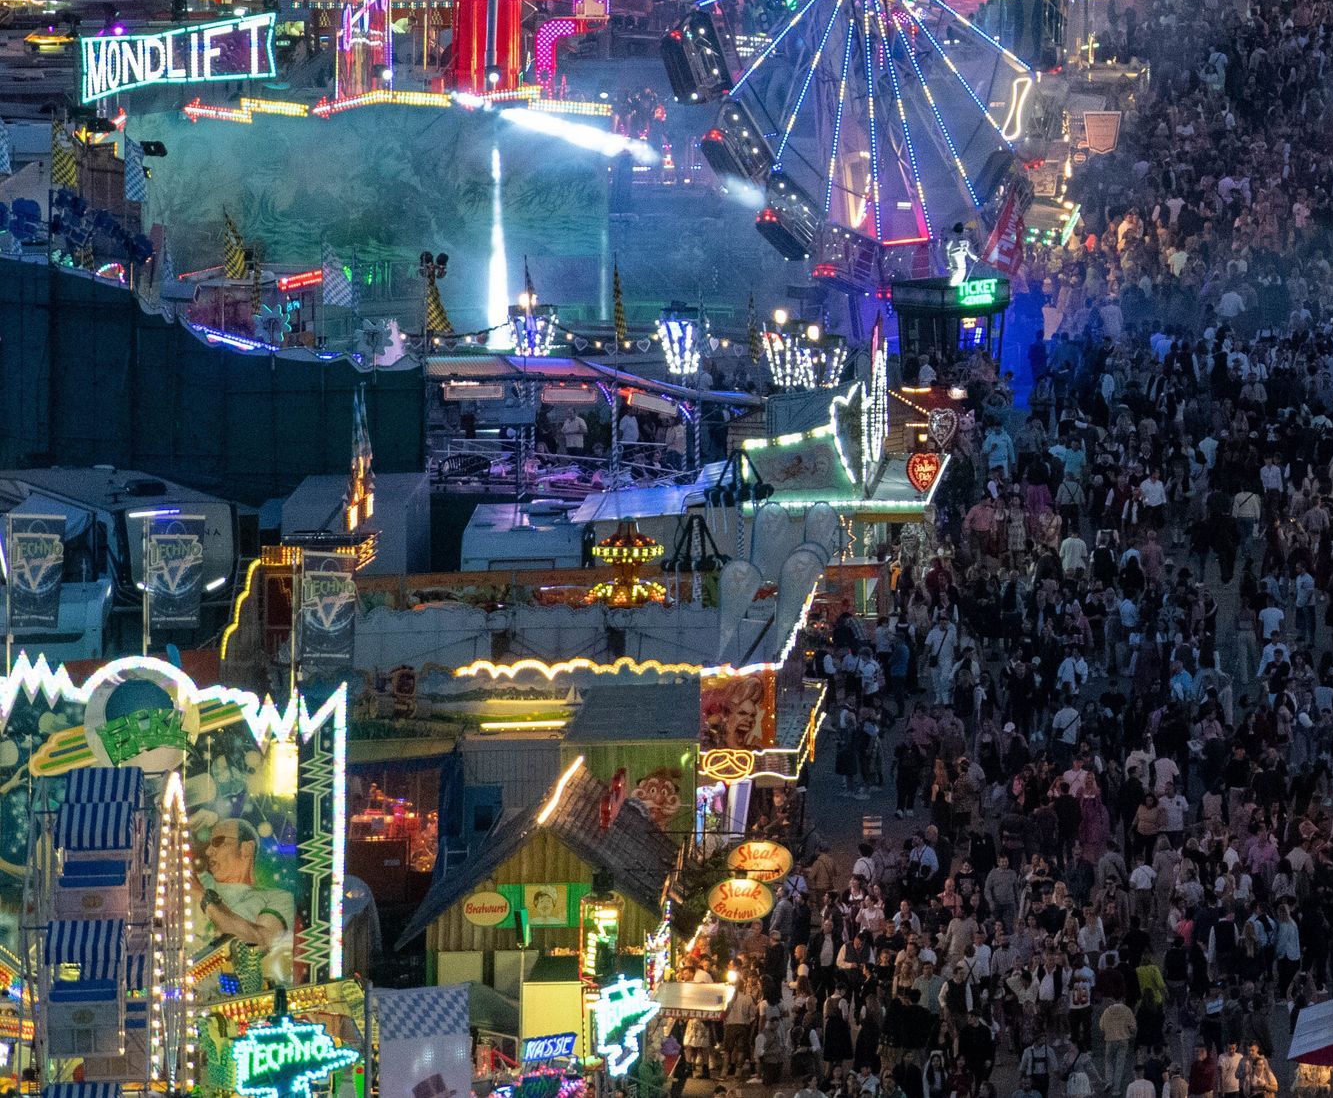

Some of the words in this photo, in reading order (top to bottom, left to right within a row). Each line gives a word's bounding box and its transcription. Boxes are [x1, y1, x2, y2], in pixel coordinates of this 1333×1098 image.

[86, 15, 269, 96] MONDLIFT
[958, 279, 998, 296] TICKET
[738, 846, 779, 863] Steak
[719, 882, 762, 900] Steak
[465, 902, 508, 914] Bratwurst
[236, 1033, 329, 1082] TECHNO
